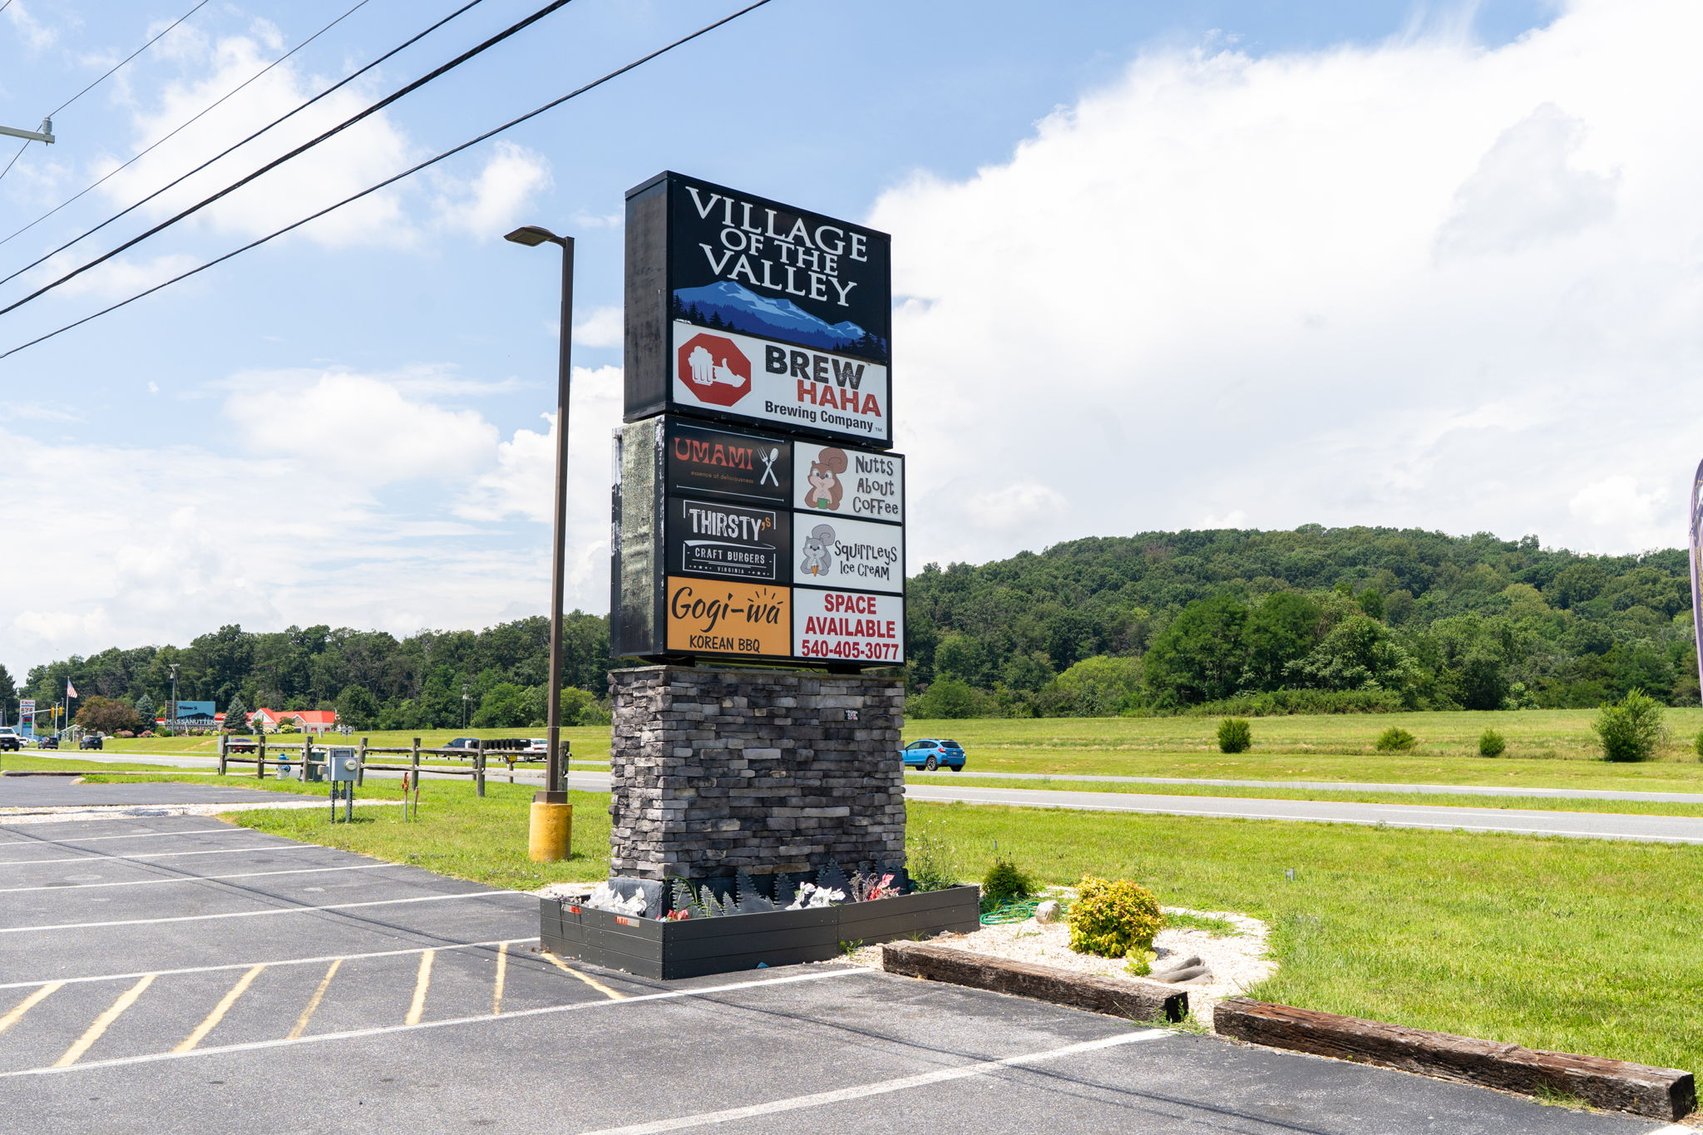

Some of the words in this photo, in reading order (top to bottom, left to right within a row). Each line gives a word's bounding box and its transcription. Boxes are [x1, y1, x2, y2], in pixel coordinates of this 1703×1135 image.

[685, 186, 868, 263] VILLAGE
[720, 228, 764, 256] OF
[774, 239, 838, 276] THE
[699, 243, 858, 307] VALLEY
[765, 345, 865, 390] BREW
[797, 379, 881, 417] HAHA
[765, 400, 817, 423] Brewing
[820, 410, 873, 432] Company
[673, 437, 754, 471] UMAMI
[856, 476, 895, 496] About
[694, 547, 723, 560] CRAFT
[727, 551, 765, 564] BURGERS
[717, 566, 745, 574] VIRGINIA
[839, 561, 855, 575] Ice
[824, 593, 877, 615] SPACE
[805, 615, 896, 639] AVAILABLE
[689, 634, 734, 651] KOREAN
[738, 638, 760, 653] BBQ
[801, 639, 899, 660] 540-405-3077
